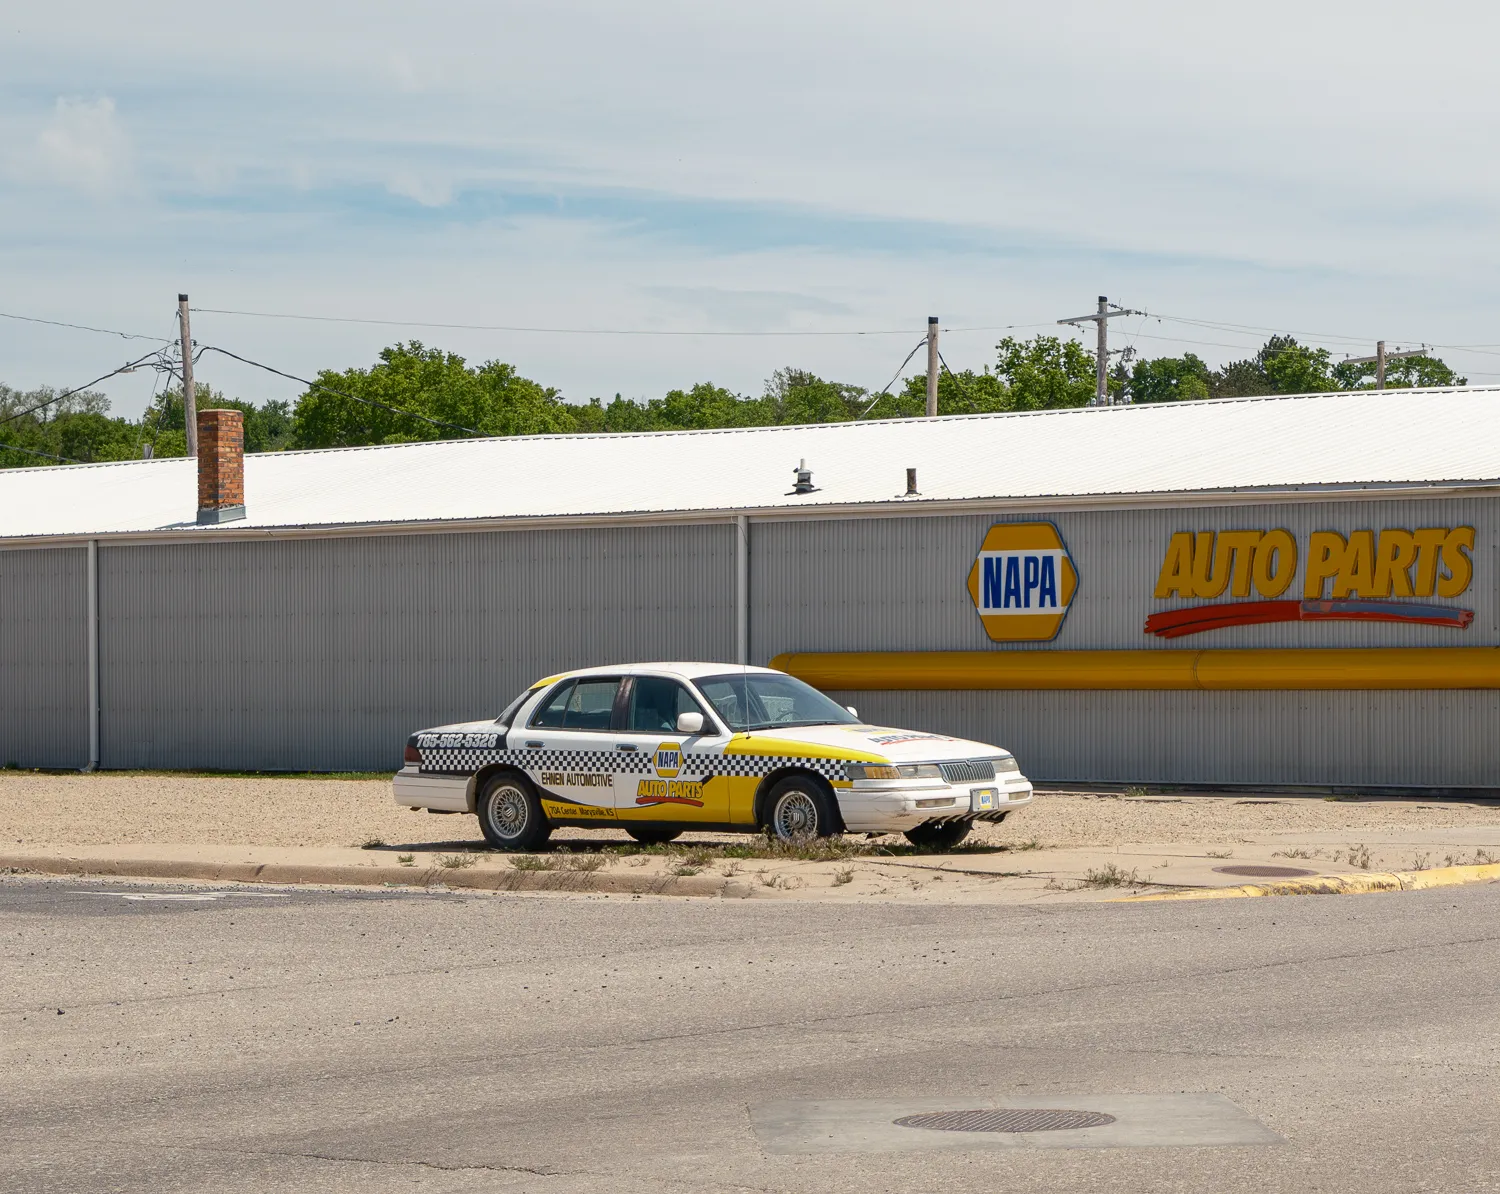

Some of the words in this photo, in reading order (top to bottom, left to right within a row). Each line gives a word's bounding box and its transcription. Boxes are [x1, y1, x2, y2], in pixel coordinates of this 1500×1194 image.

[1154, 528, 1298, 599] AUTO
[1303, 525, 1476, 599] PARTS
[982, 555, 1057, 609] NAPA
[416, 733, 498, 748] 785-562-5328
[658, 751, 679, 768] NAPA
[541, 772, 564, 786] EHNEN
[566, 773, 613, 787] AUTOMOTIVE
[637, 780, 667, 797] AUTO
[668, 780, 703, 798] PARTS
